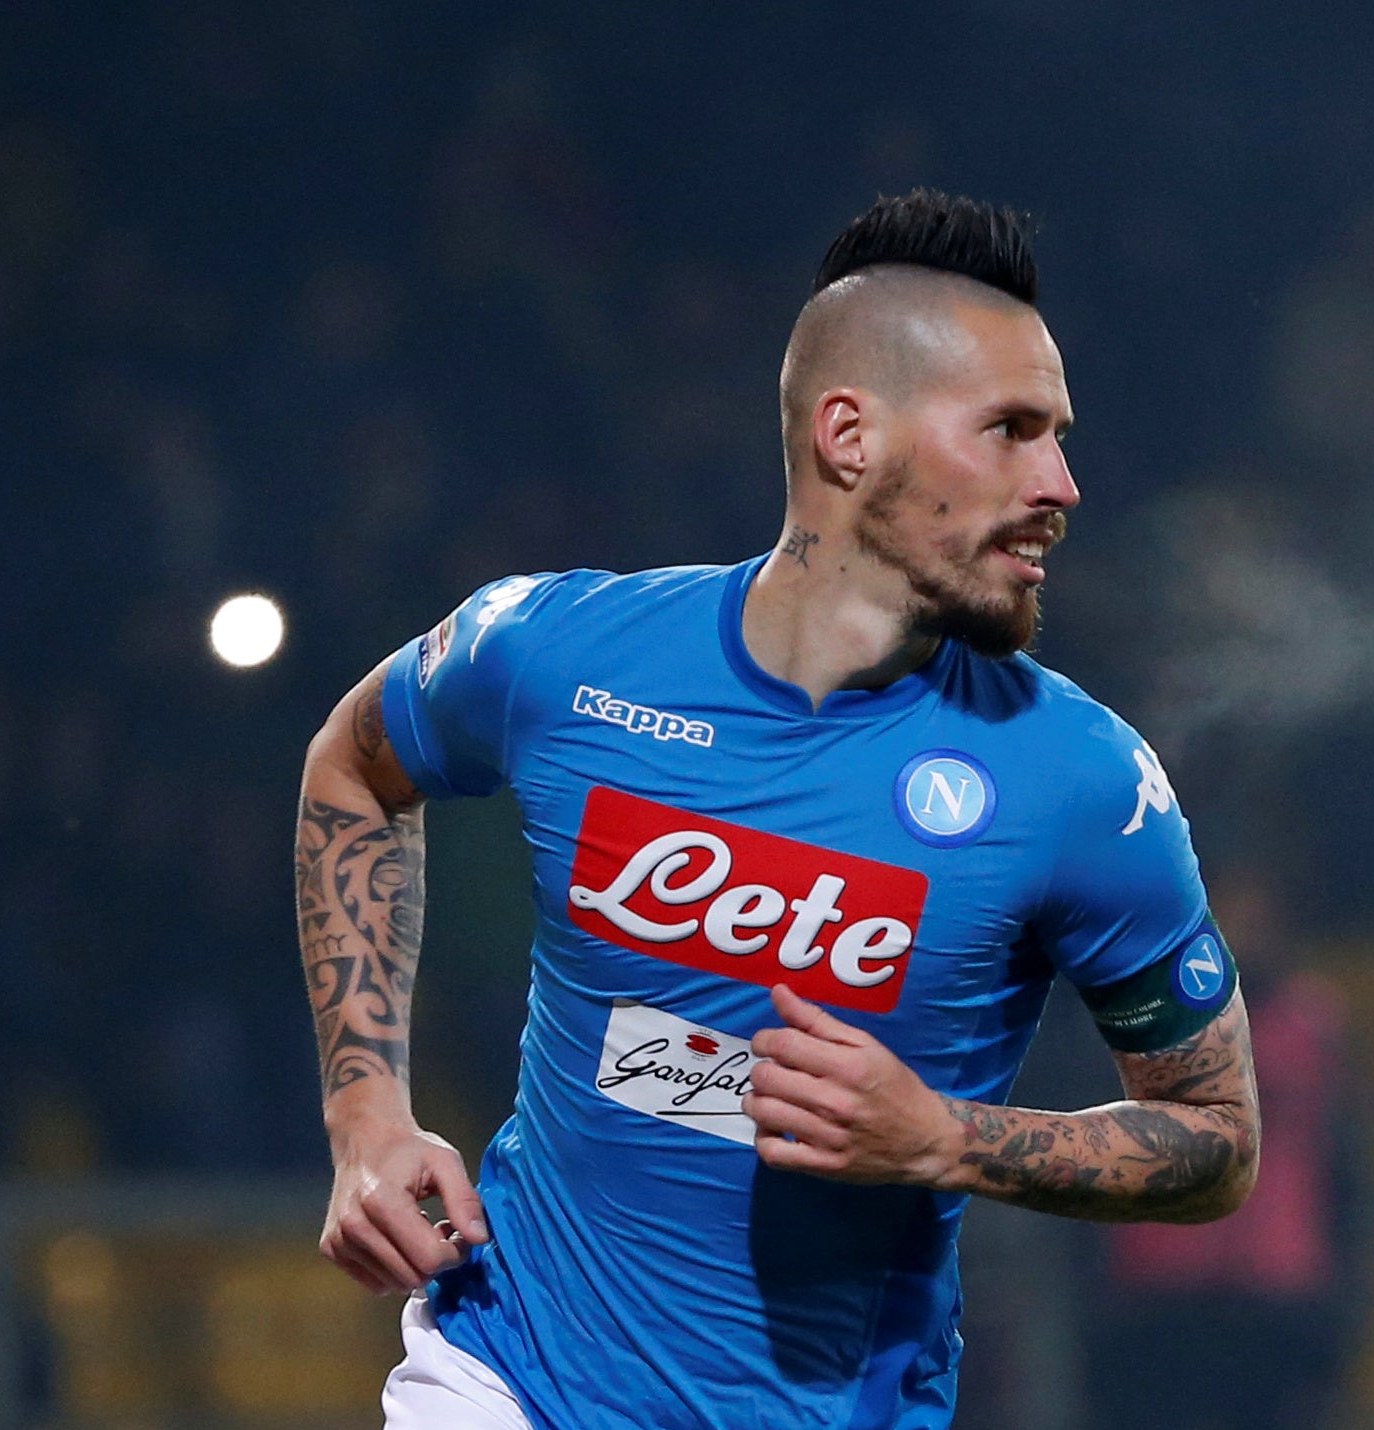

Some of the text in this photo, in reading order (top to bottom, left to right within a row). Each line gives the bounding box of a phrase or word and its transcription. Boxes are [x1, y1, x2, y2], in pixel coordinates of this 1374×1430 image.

[573, 685, 714, 747] Kappa
[920, 770, 972, 823] N
[569, 830, 913, 988] Lete
[1185, 942, 1220, 993] N
[597, 1038, 755, 1106] Garofal
